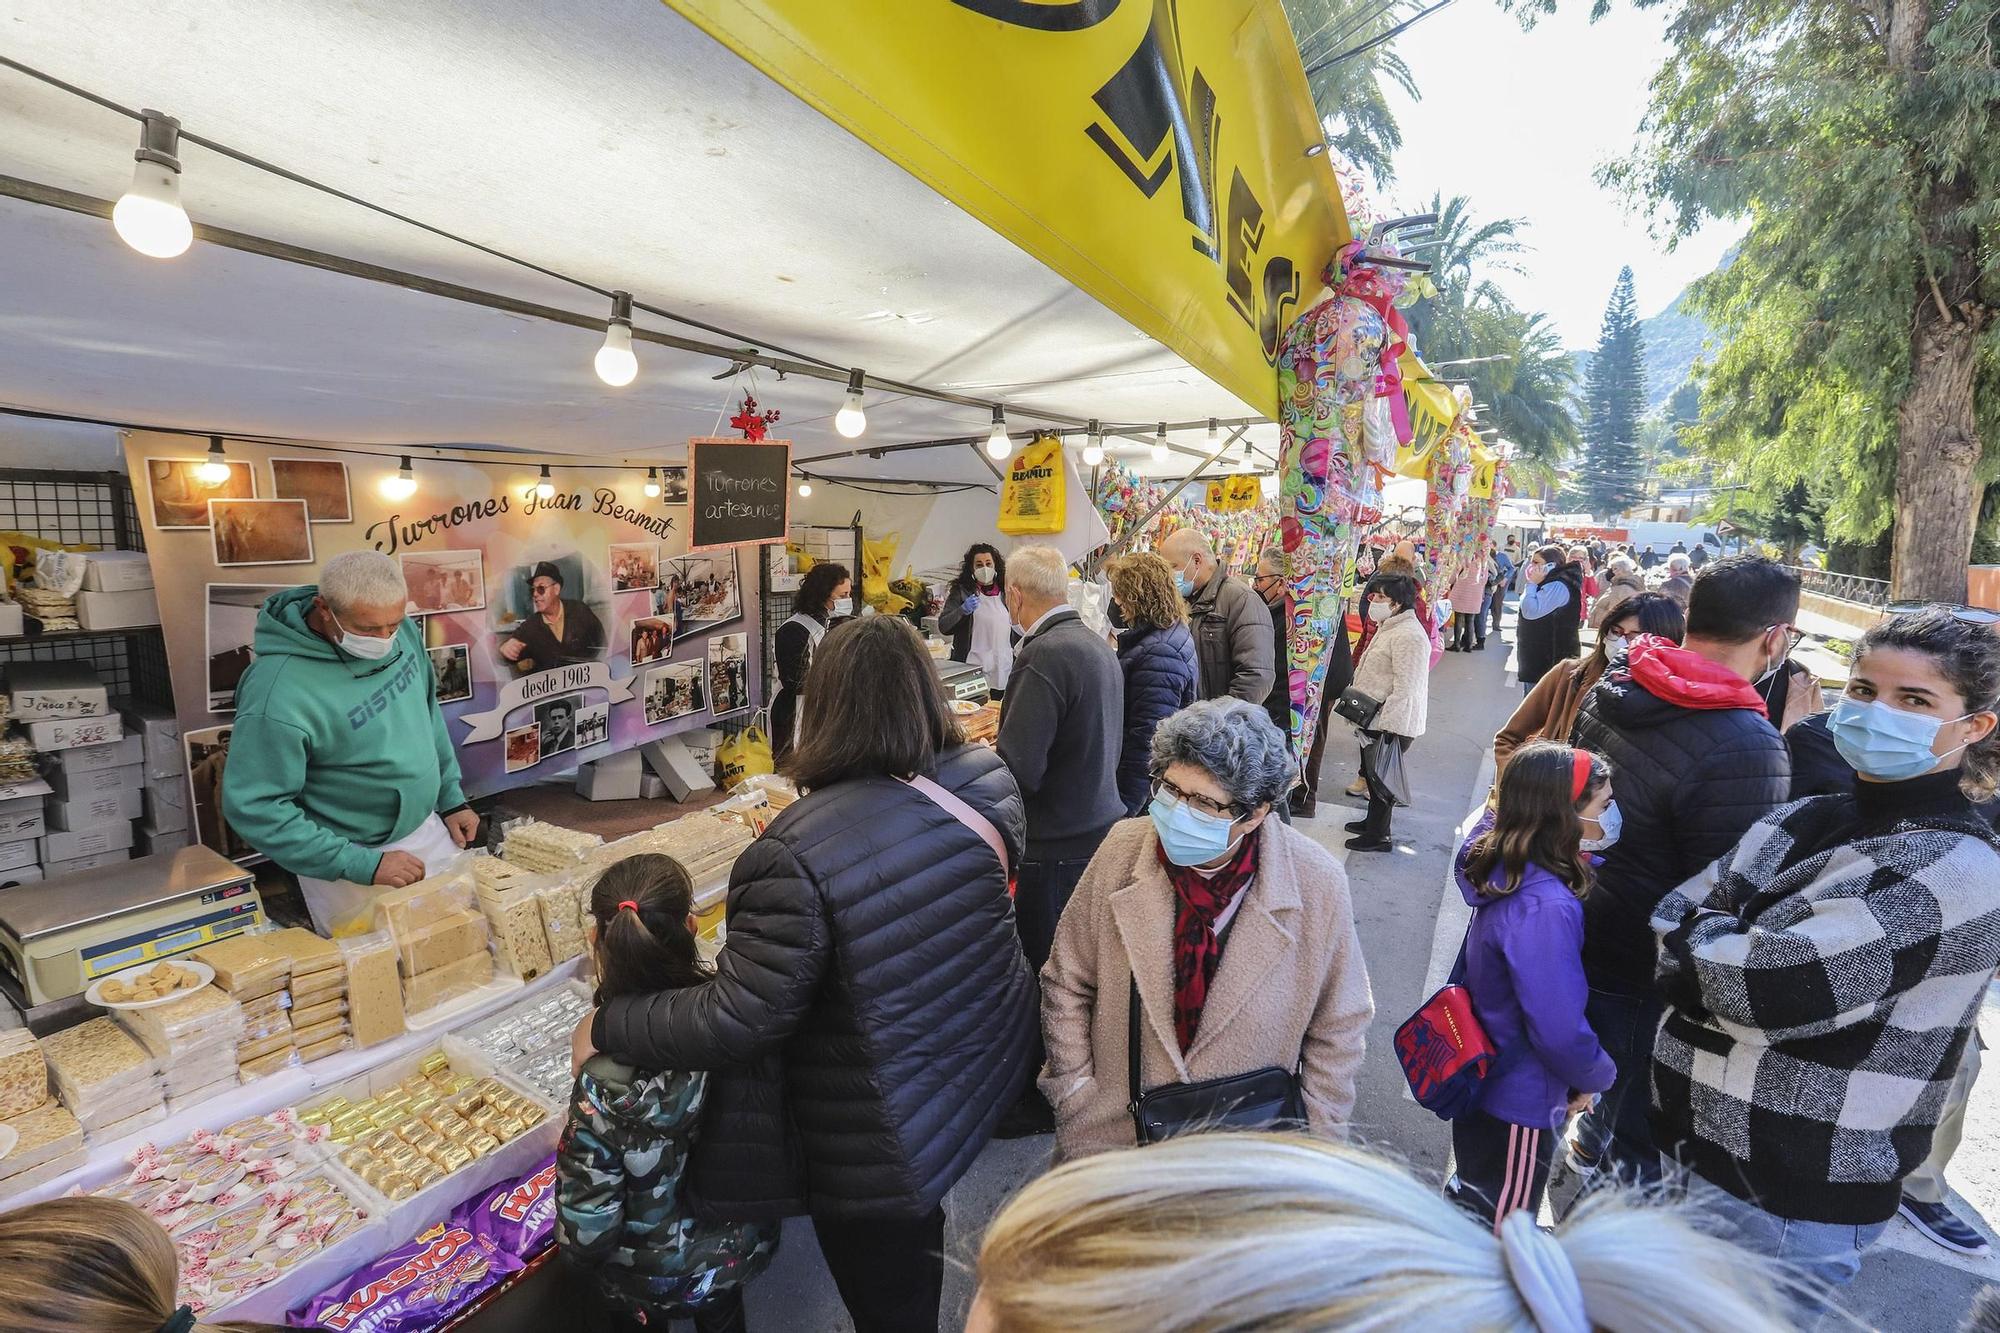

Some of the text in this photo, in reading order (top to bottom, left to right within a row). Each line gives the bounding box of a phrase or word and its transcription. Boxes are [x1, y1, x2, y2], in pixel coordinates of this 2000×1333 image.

[702, 470, 778, 493] Turrones
[1012, 467, 1053, 481] BEAMUT
[365, 494, 510, 556] Turrones
[592, 487, 678, 540] Beamut
[705, 498, 781, 521] artesanos
[347, 652, 419, 731] DISTORT
[521, 664, 592, 700] desde 1903
[325, 1229, 473, 1330] HUESITOS
[350, 1298, 402, 1333] Mini
